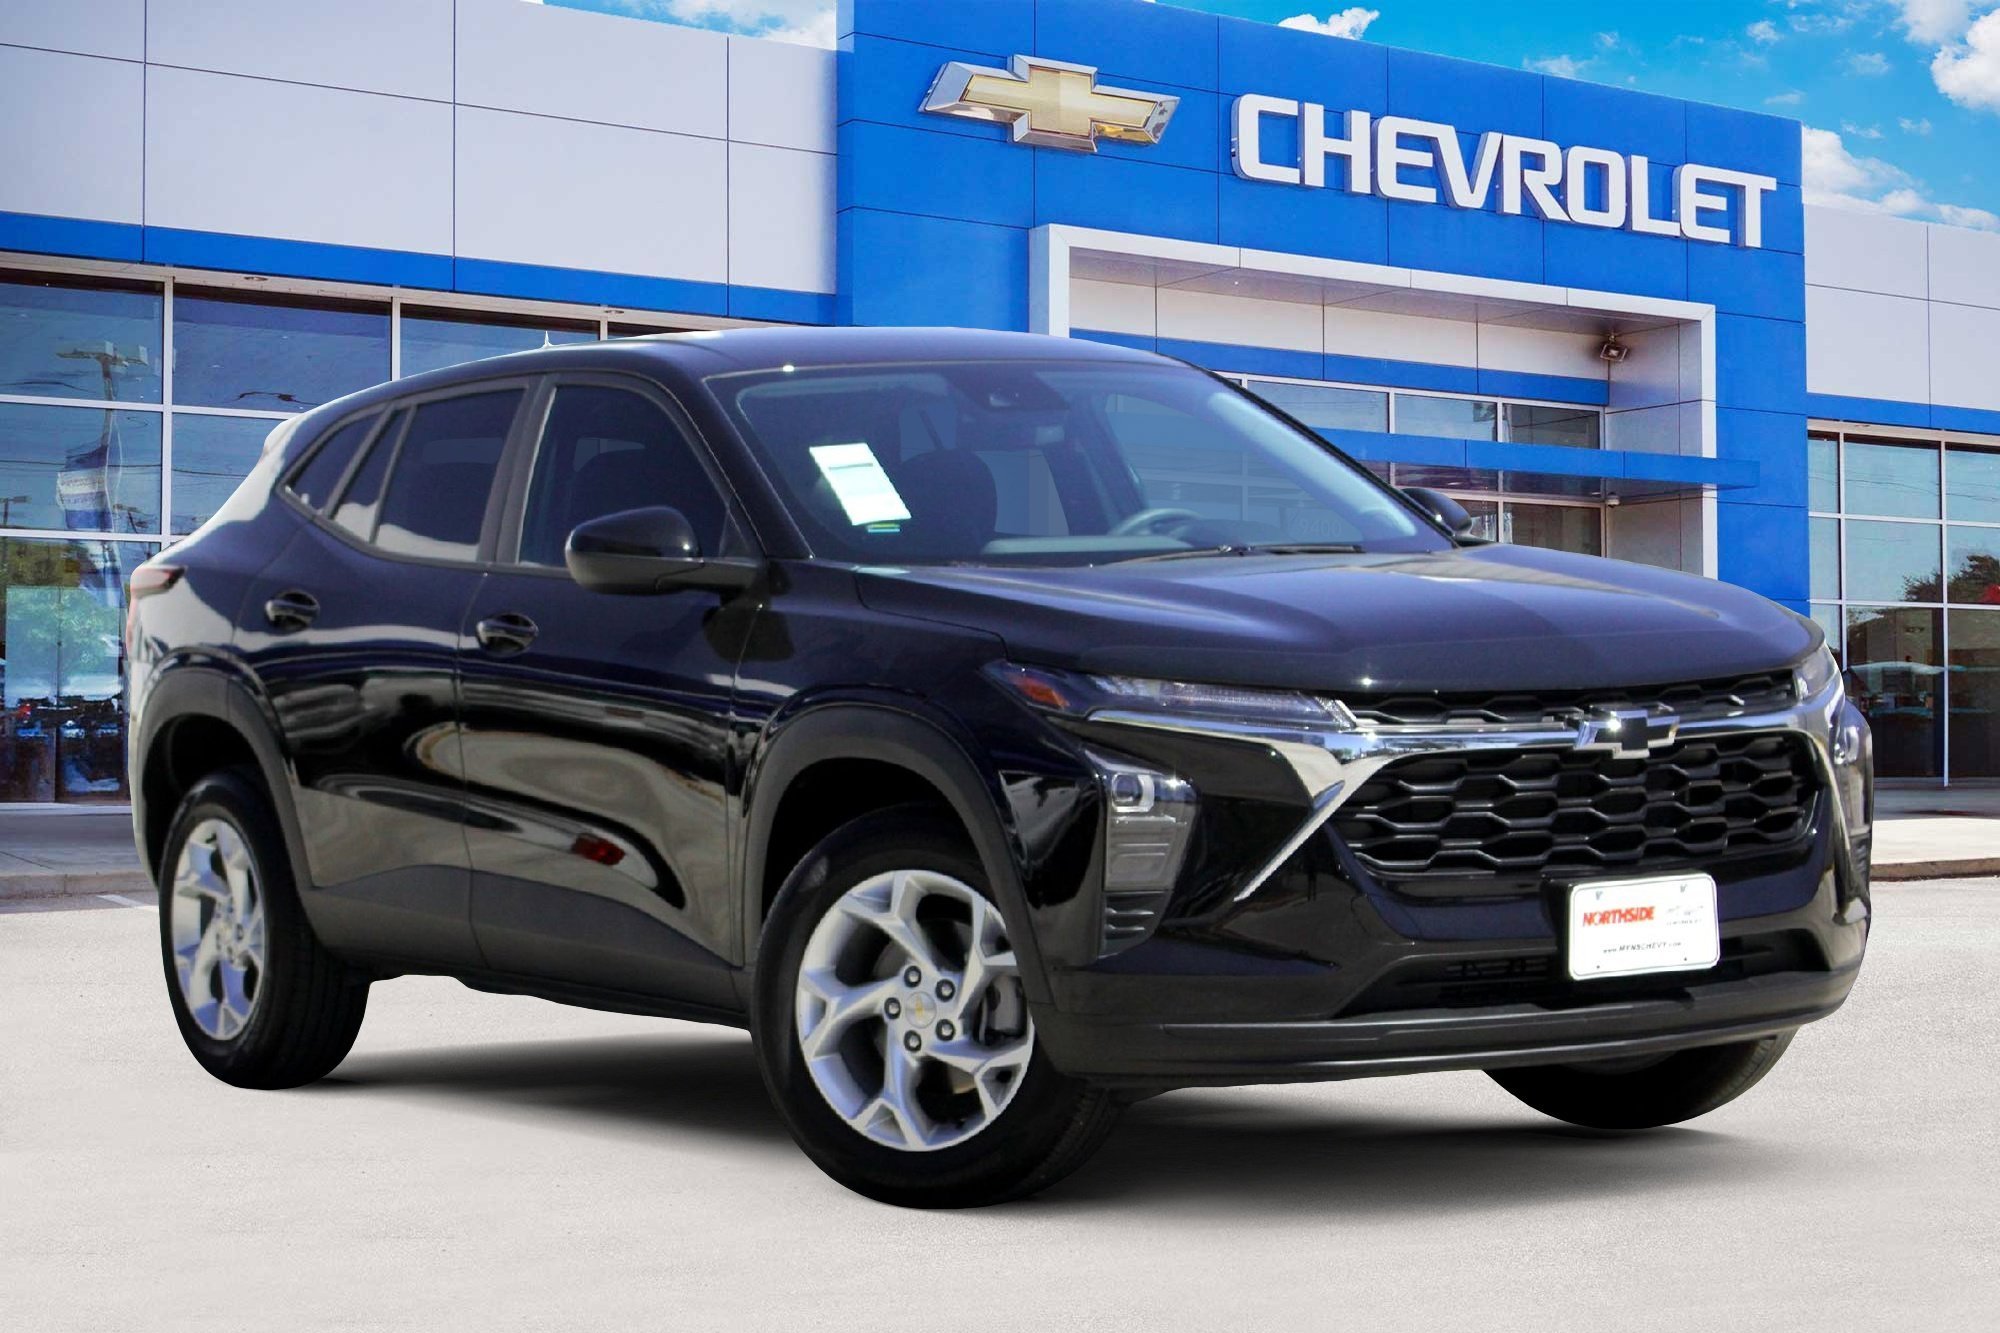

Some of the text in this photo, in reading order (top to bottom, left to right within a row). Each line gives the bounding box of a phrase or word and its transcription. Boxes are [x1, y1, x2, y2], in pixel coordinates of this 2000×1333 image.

[1231, 93, 1778, 248] CHEVROLET
[1301, 519, 1342, 537] 9400
[1583, 905, 1656, 928] NORTHSIDE
